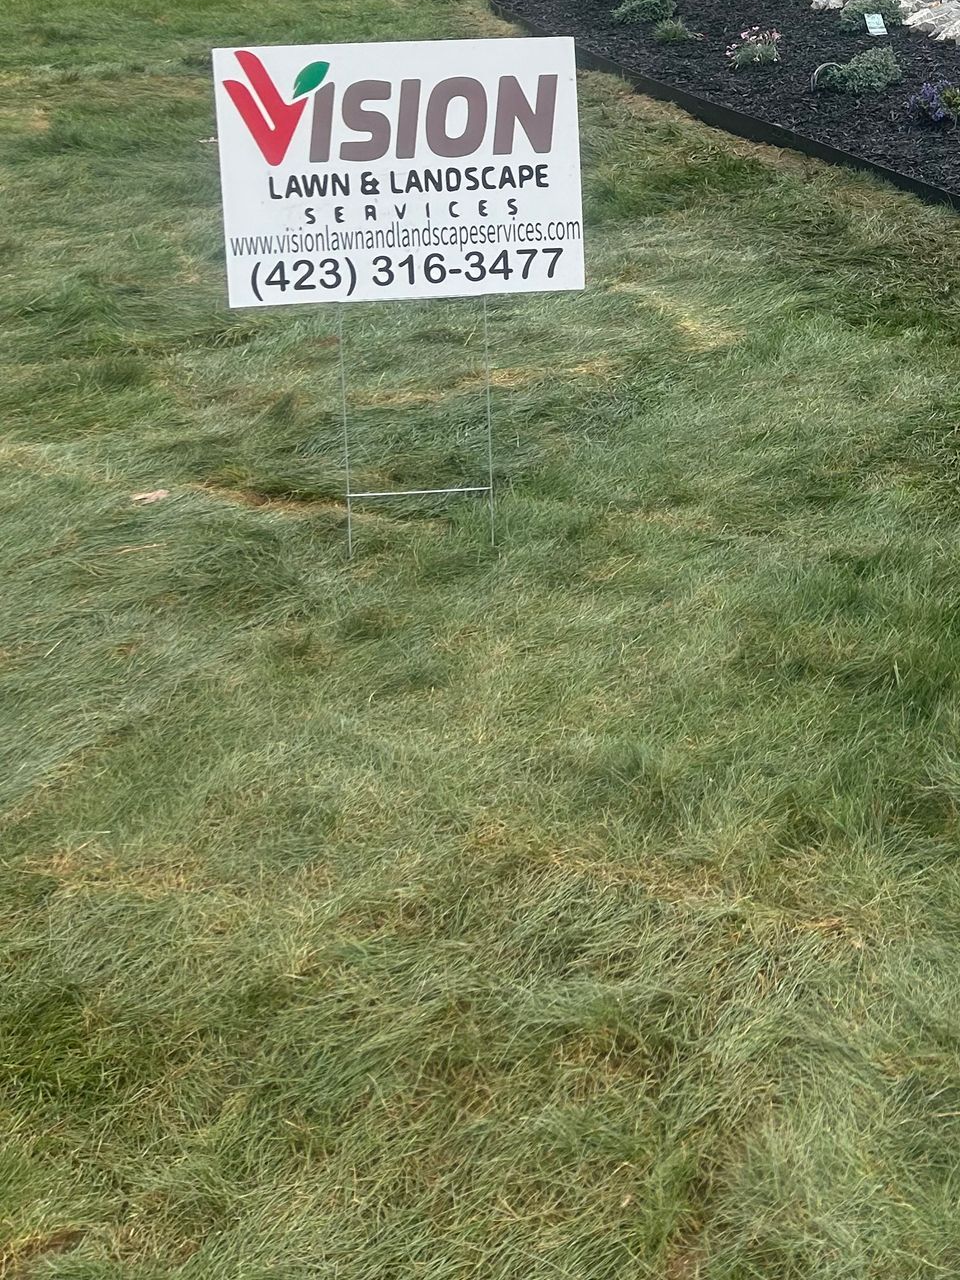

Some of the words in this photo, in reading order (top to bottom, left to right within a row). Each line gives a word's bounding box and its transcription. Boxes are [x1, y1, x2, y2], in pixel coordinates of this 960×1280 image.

[223, 50, 558, 166] VISION
[268, 172, 351, 200] LAWN
[360, 171, 380, 195] &
[390, 164, 549, 194] LANDSCAPE
[304, 198, 518, 225] SERVICES
[230, 216, 581, 257] www.visionlawnandlandscapeservices.com
[251, 257, 357, 301] (423)
[372, 247, 564, 286] 316-3477
